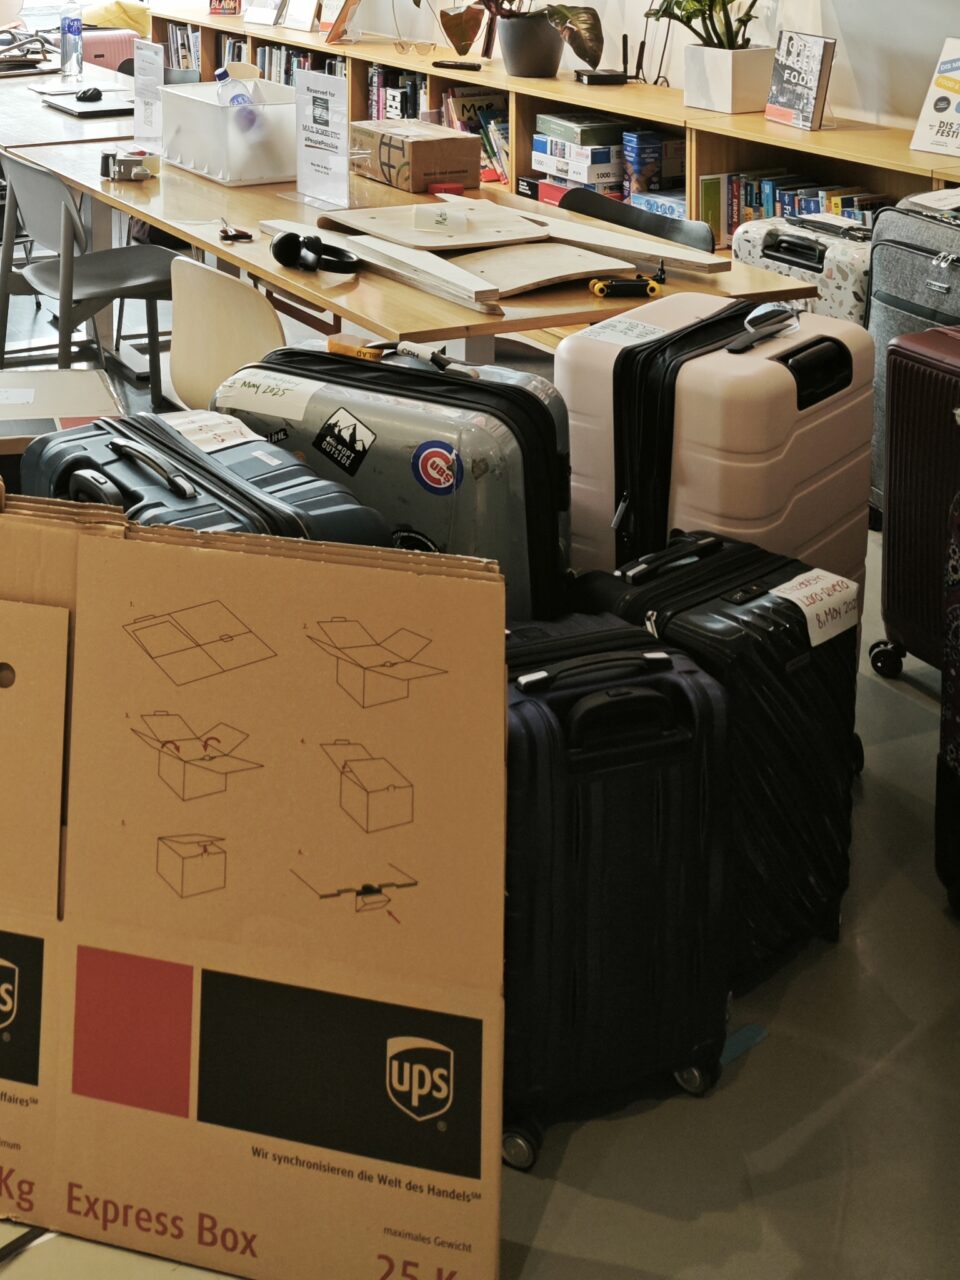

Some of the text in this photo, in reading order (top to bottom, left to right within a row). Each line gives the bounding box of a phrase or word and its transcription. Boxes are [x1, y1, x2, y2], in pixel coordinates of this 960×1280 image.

[211, 0, 236, 9] BLACK
[783, 69, 815, 87] FOOD
[307, 86, 328, 96] Reserved
[939, 121, 954, 131] DIS
[596, 171, 611, 180] 1000
[241, 381, 294, 397] May 2025
[321, 441, 351, 467] OUTSIDE
[392, 1059, 448, 1107] ups
[251, 1145, 269, 1160] Wir
[272, 1152, 354, 1179] synchronisieren
[357, 1169, 374, 1183] die
[377, 1173, 402, 1189] Welt
[405, 1179, 424, 1194] des
[66, 1180, 259, 1258] Express Box
[383, 1226, 472, 1253] maximales Gewicht
[377, 1253, 420, 1280] 25
